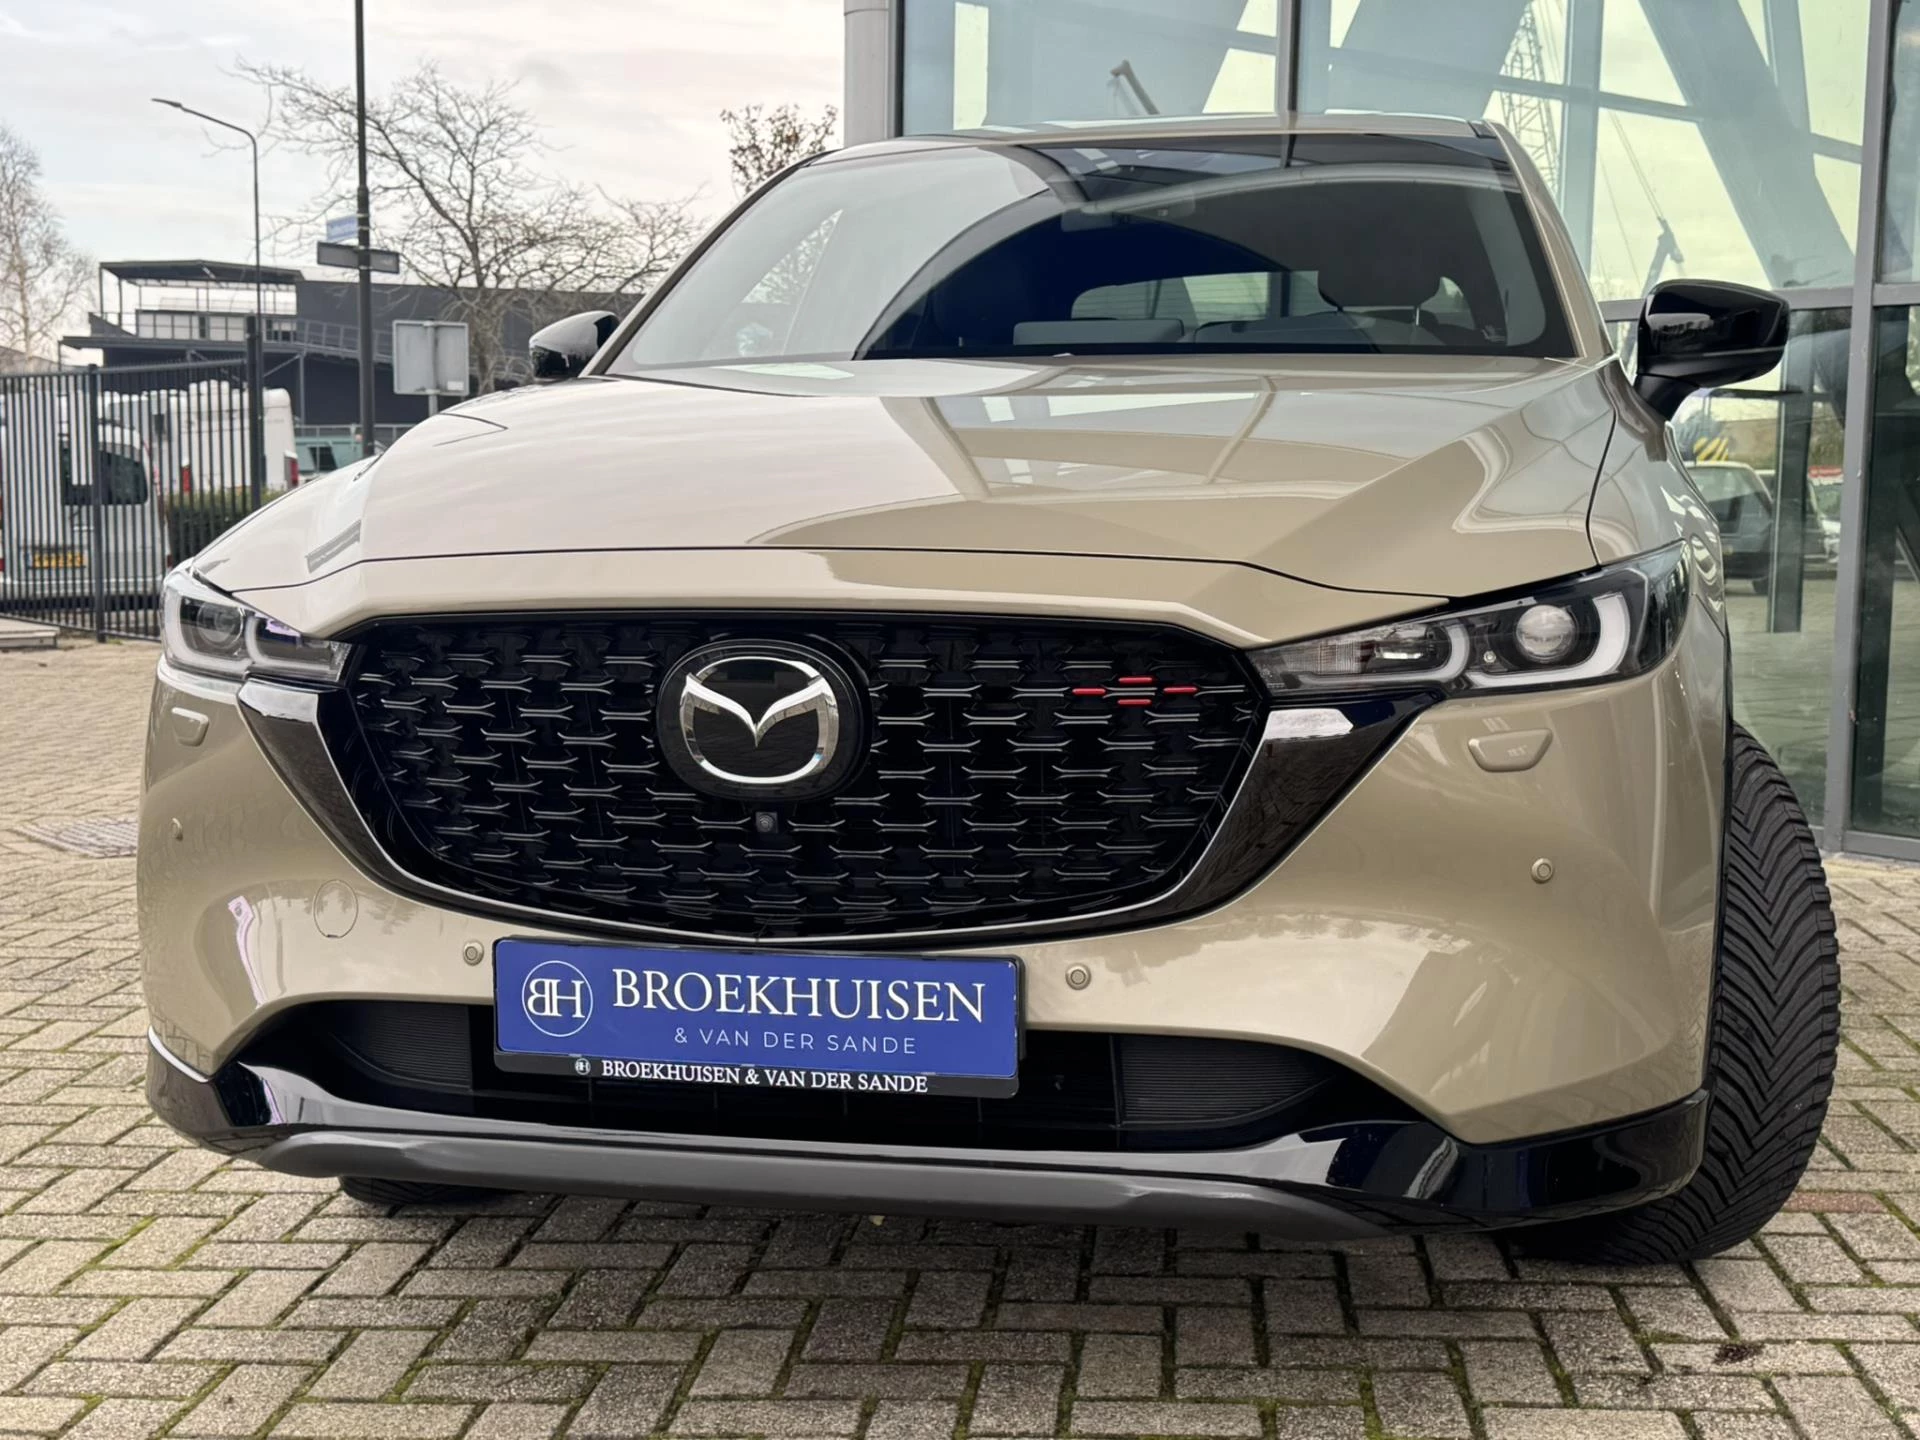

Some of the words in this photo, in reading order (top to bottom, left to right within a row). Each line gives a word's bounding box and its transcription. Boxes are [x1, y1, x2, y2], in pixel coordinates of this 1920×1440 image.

[612, 968, 986, 1024] BROEKHUISEN
[674, 1027, 688, 1044] &
[699, 1029, 749, 1047] VAN
[764, 1031, 814, 1050] DER
[827, 1034, 917, 1055] SANDE
[602, 1060, 741, 1084] BROEKHUISEN
[745, 1069, 760, 1085] &
[764, 1069, 806, 1088] VAN
[811, 1072, 854, 1090] DER
[858, 1075, 929, 1093] SANDE
